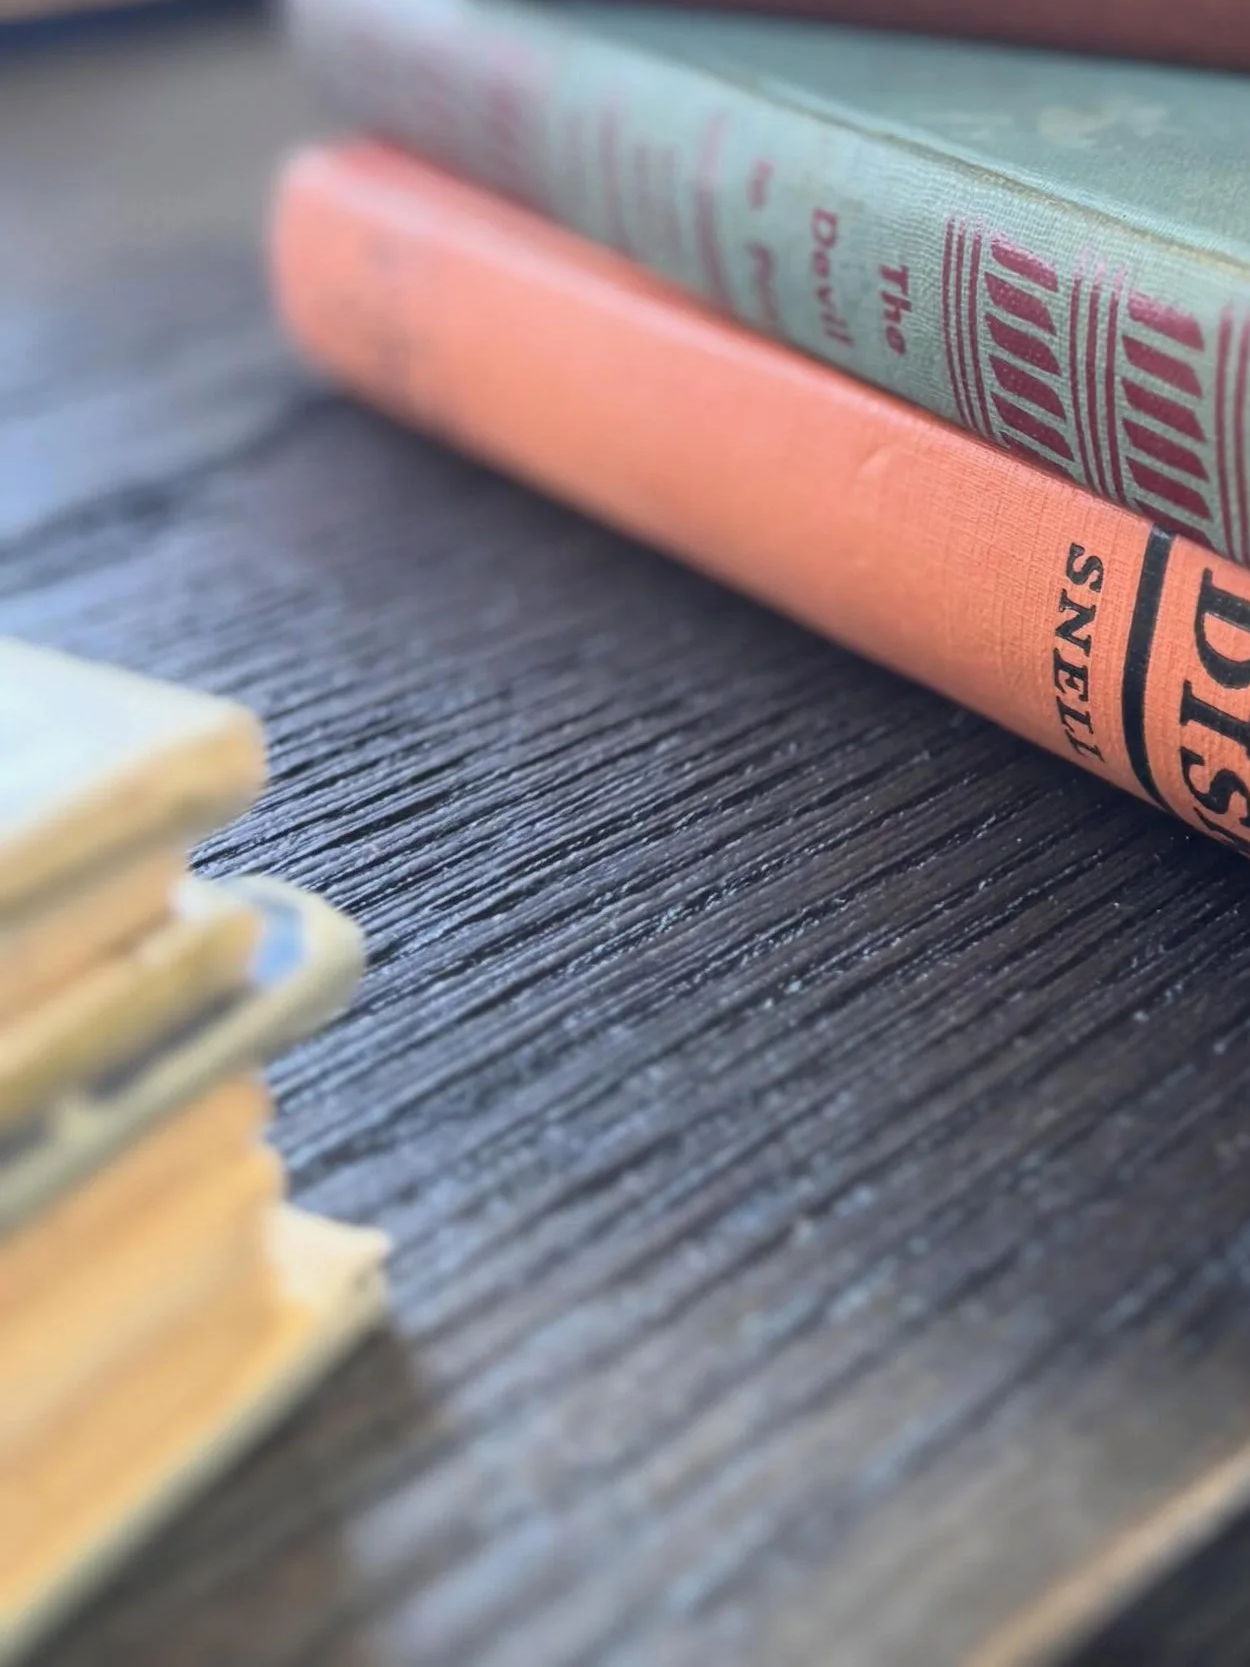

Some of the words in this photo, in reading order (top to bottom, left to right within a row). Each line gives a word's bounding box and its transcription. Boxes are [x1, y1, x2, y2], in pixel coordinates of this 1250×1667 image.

[811, 207, 856, 347] Devil
[878, 264, 913, 356] The
[1052, 541, 1106, 764] SNELL
